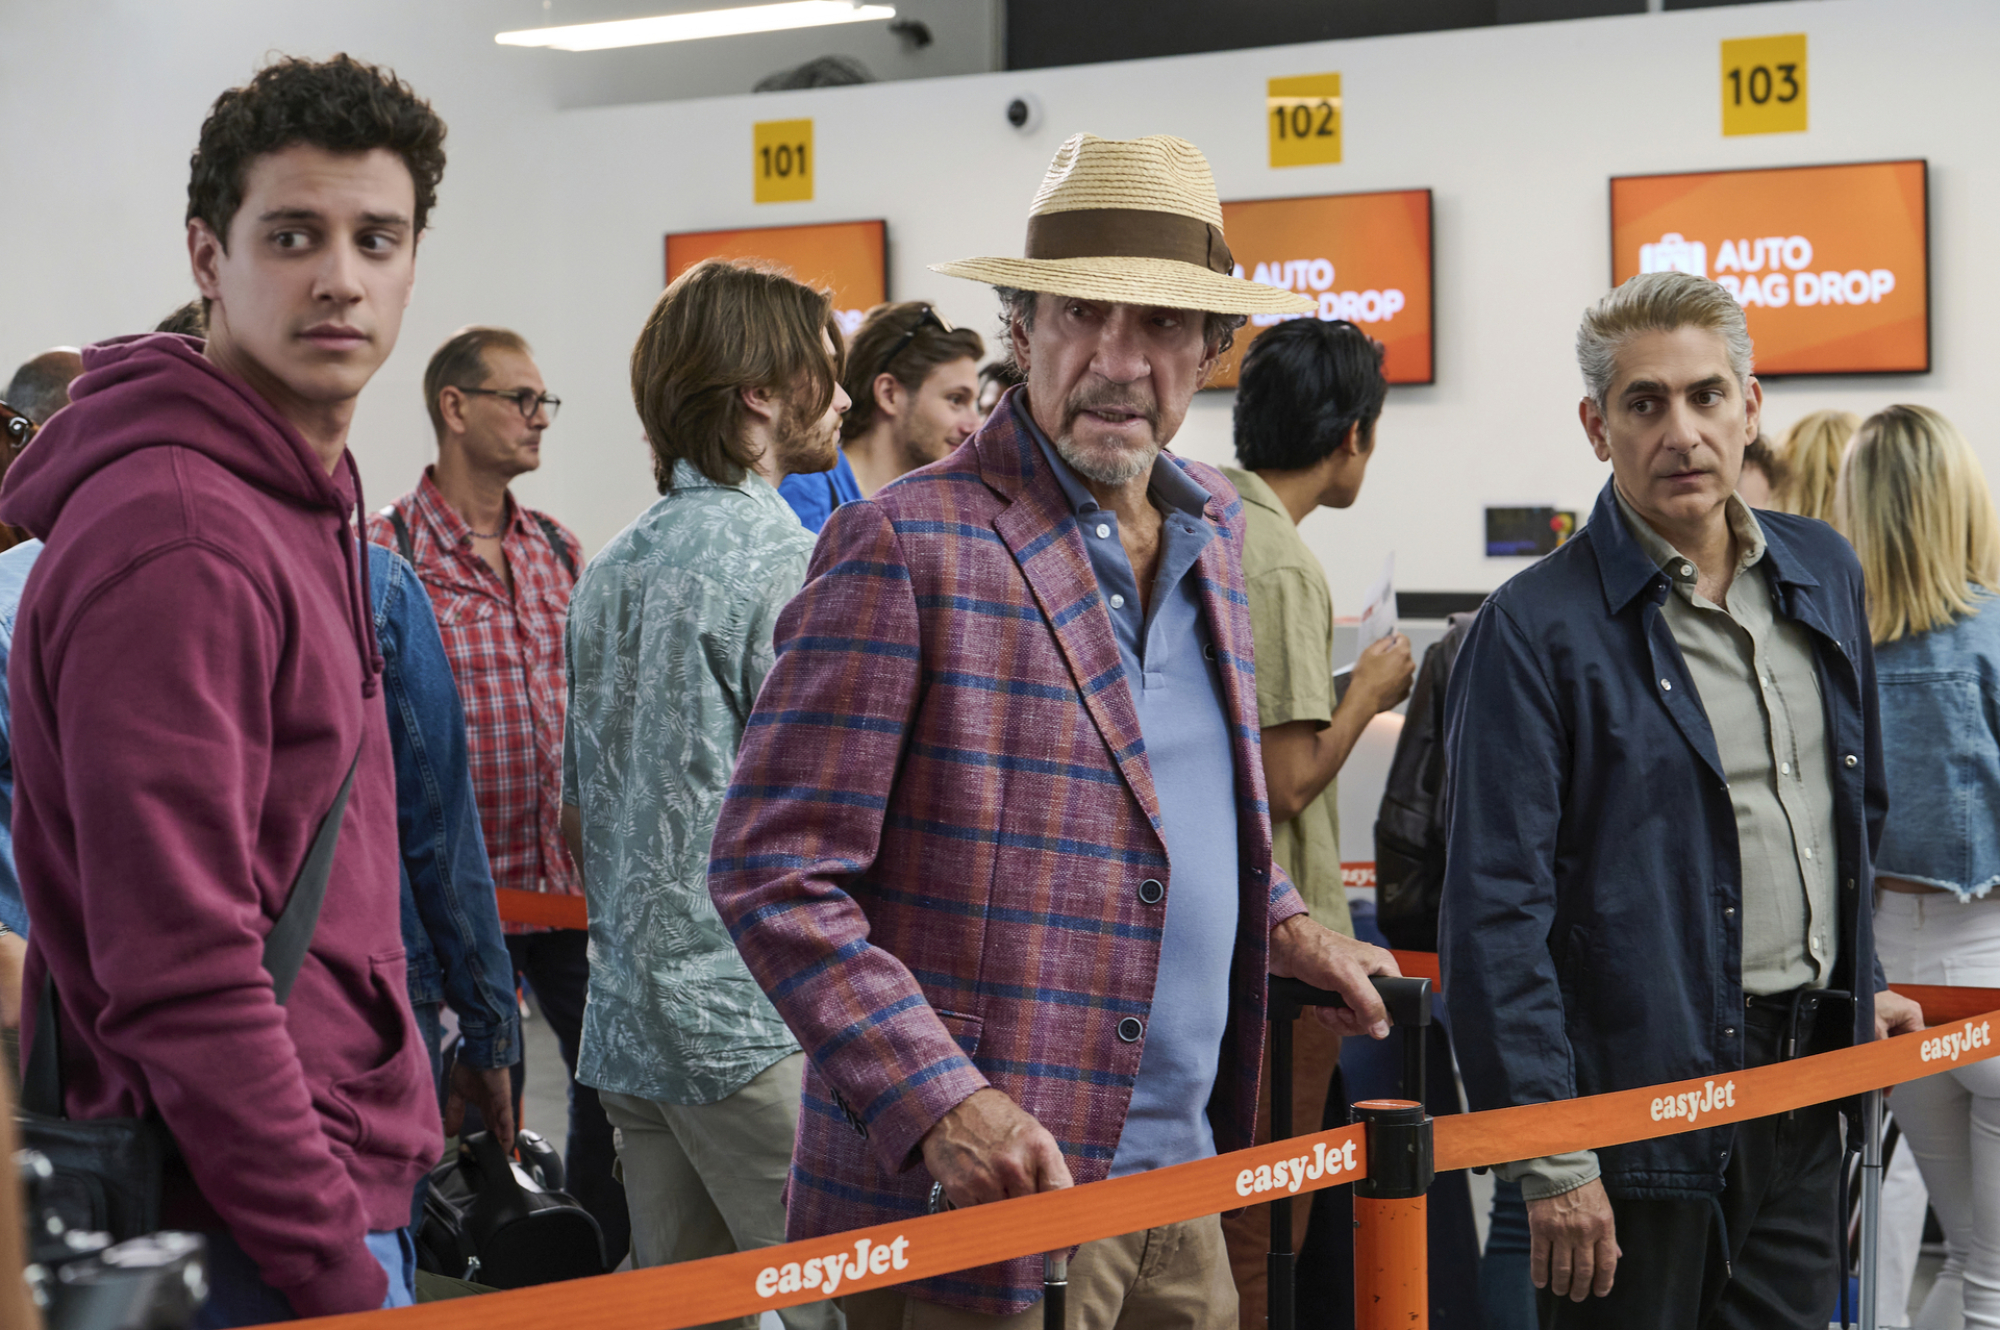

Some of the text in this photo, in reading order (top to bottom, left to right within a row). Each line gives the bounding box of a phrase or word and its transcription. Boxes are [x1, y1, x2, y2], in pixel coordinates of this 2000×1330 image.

[1727, 62, 1800, 106] 103
[1275, 102, 1335, 140] 102
[760, 143, 807, 179] 101
[1713, 235, 1813, 273] AUTO
[1252, 258, 1335, 291] AUTO
[1793, 269, 1895, 306] DROP
[1317, 288, 1405, 322] DROP
[1919, 1020, 1991, 1063] easyJet
[1650, 1079, 1736, 1123] easyJet
[1235, 1139, 1358, 1197] easyJet
[755, 1234, 910, 1299] easyJet
